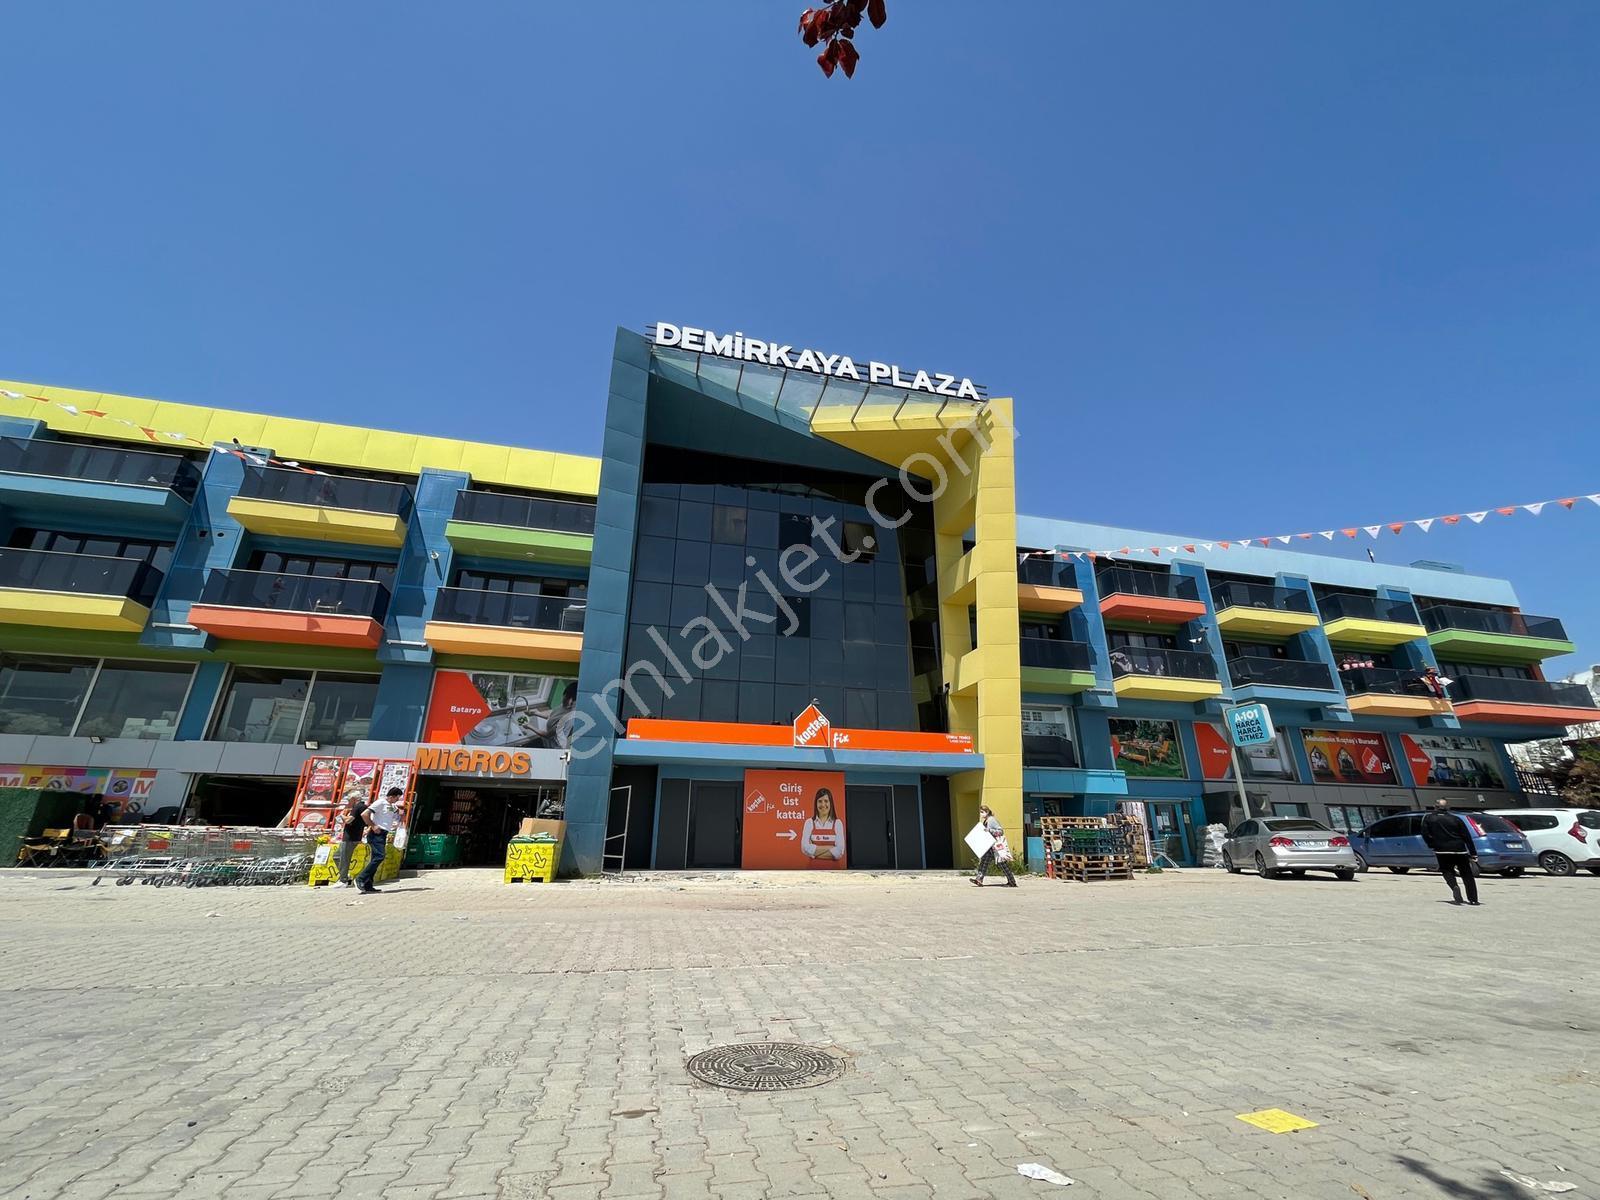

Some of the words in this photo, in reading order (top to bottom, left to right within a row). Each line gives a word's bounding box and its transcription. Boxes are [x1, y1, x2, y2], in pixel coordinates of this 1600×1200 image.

[656, 322, 860, 380] DEMİRKAYA
[869, 361, 980, 400] PLAZA
[450, 705, 482, 714] Batarya
[1235, 719, 1261, 729] HARCA
[796, 715, 828, 745] koçtaş
[833, 732, 849, 748] fix
[1237, 725, 1263, 736] HARCA
[779, 783, 803, 796] Giriş
[783, 796, 799, 806] üst
[776, 810, 805, 820] katta!
